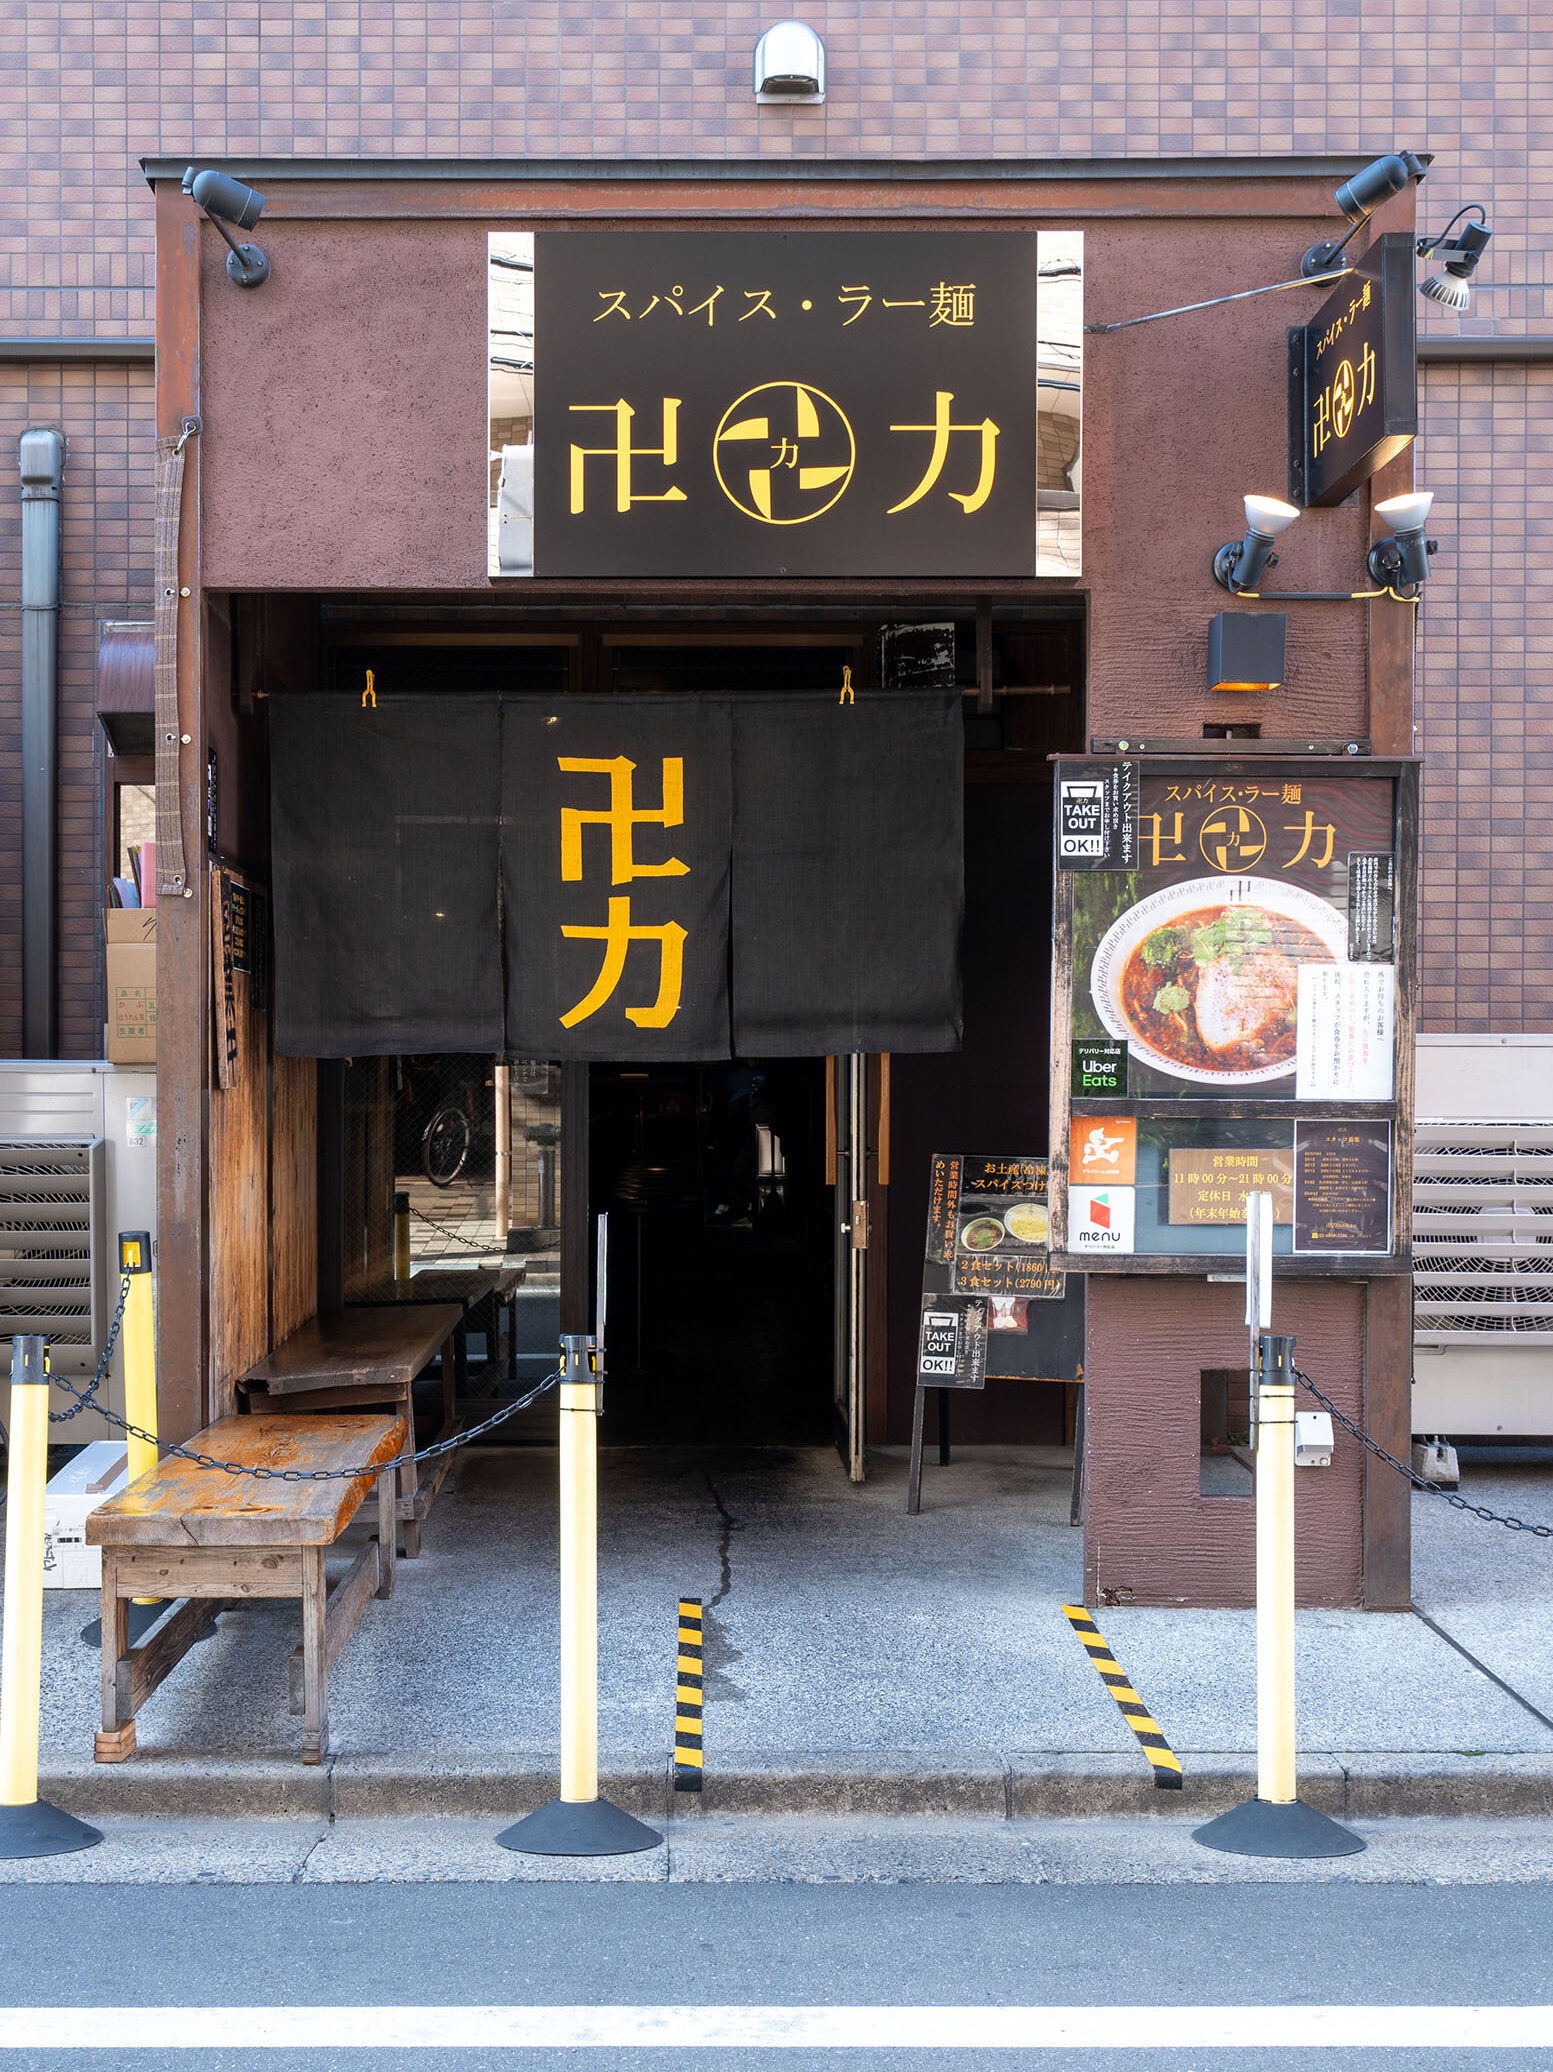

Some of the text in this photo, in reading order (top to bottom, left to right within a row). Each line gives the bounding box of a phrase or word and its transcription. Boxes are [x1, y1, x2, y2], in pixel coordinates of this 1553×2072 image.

[593, 281, 977, 328] スパイス・ラー麺
[1317, 280, 1371, 360] スパイス・ラー麺
[1314, 386, 1331, 458] 卍
[1357, 342, 1375, 416] 力
[569, 397, 687, 515] 卍
[887, 391, 1000, 515] 力
[1164, 784, 1302, 804] スパイス・ラー麺
[1064, 804, 1101, 816] TAKE
[1121, 761, 1133, 864] テイクアウト出来ます
[1068, 818, 1097, 829] OUT
[1064, 839, 1100, 853] OK!!
[1281, 810, 1336, 869] 力
[557, 755, 691, 1029] 卍力
[1082, 1060, 1117, 1073] Uber
[1082, 1075, 1117, 1087] Eats
[1212, 1155, 1259, 1168] 営業時間
[984, 1162, 1049, 1175] お土産(冷凍
[975, 1178, 1048, 1191] スパイスつけ
[931, 1160, 946, 1228] めいただけます。
[1198, 1190, 1231, 1202] 定休日
[1079, 1231, 1121, 1242] menu
[960, 1260, 1054, 1274] 2食セット(1860
[925, 1331, 955, 1341] TAKE
[970, 1299, 985, 1383] テイクアウト出来ます
[928, 1342, 952, 1352] OUT
[923, 1359, 954, 1371] OK!!
